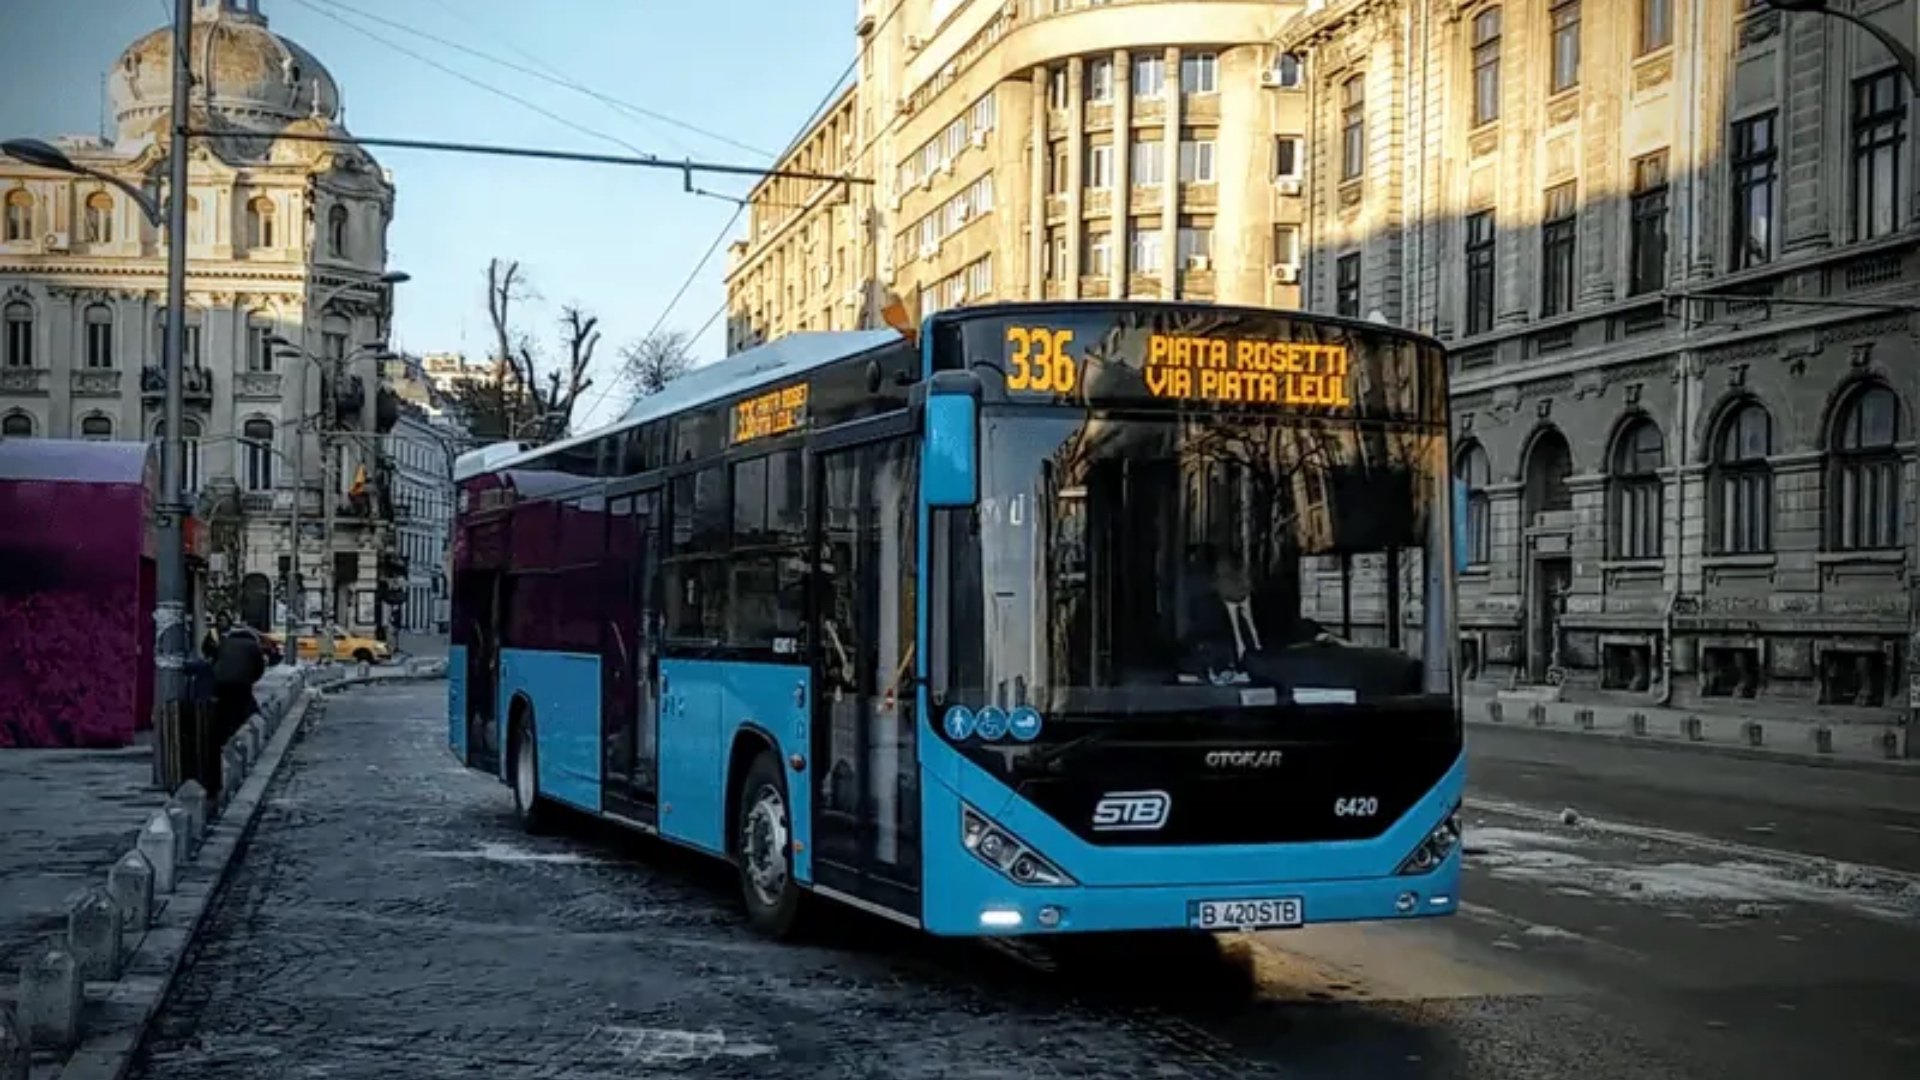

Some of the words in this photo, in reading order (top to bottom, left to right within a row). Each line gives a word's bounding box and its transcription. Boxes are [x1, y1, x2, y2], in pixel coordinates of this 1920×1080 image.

[1007, 326, 1075, 392] 336
[1150, 334, 1228, 367] PIATA
[1237, 341, 1347, 375] ROSETTI
[1146, 366, 1192, 398] VIA
[1201, 368, 1277, 402] PIATA
[1285, 374, 1350, 406] LEUL
[1205, 750, 1282, 768] OTOKAR
[1093, 798, 1162, 823] STB
[1334, 796, 1378, 816] 6420
[1202, 904, 1216, 924] B
